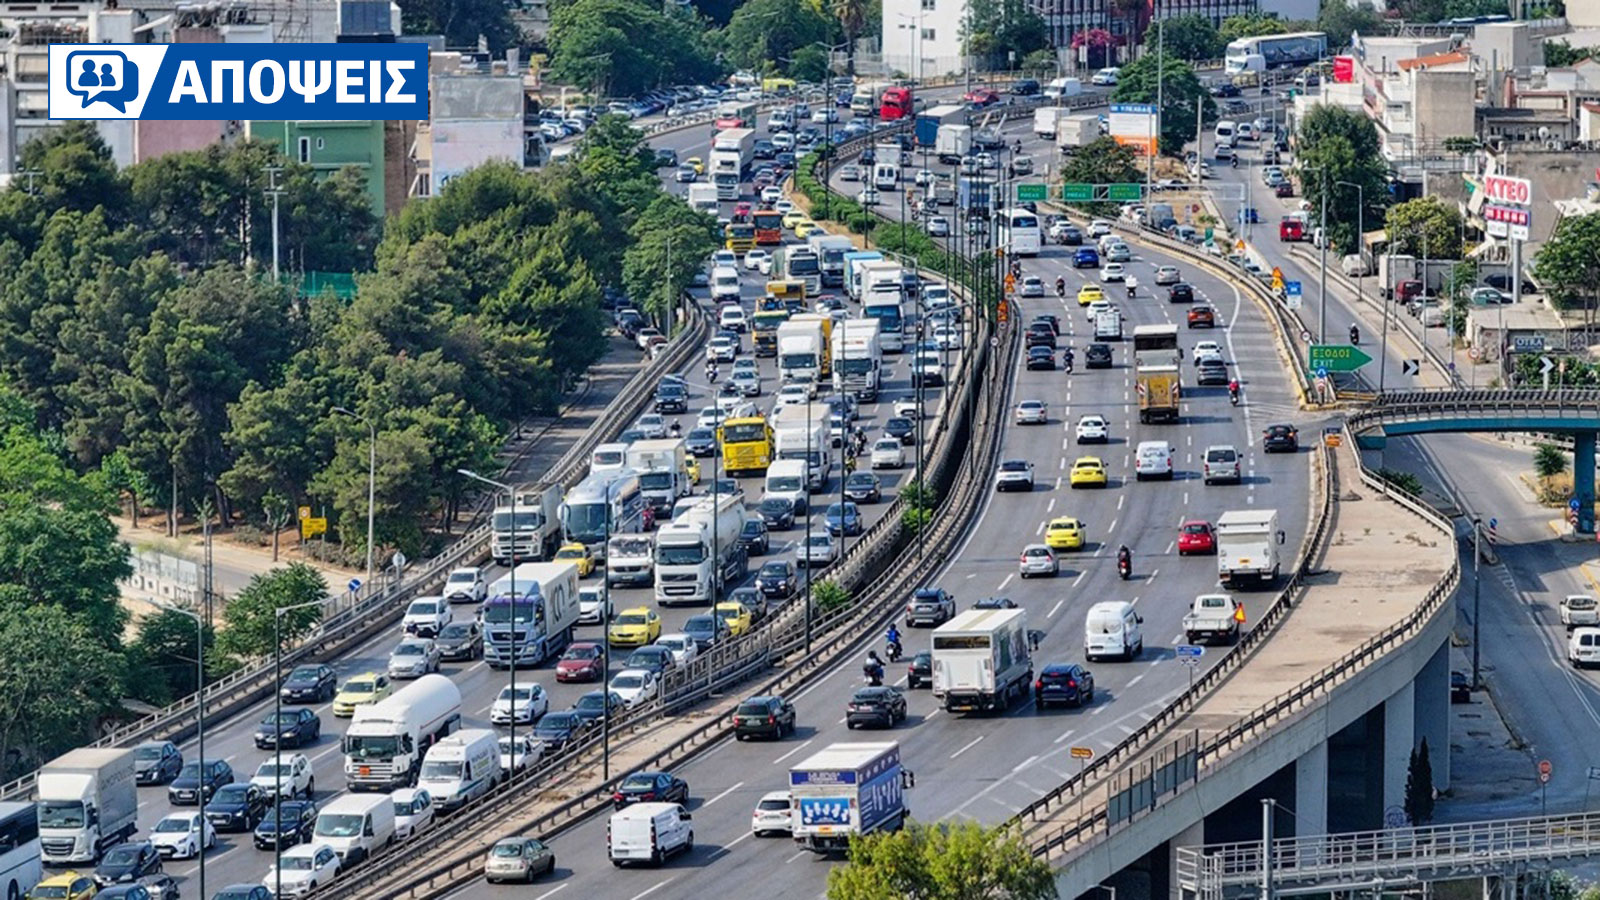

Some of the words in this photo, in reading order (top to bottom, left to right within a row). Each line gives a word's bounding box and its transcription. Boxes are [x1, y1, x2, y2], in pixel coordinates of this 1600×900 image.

[1485, 176, 1528, 203] ΚΤΕΟ
[1312, 348, 1351, 358] ΕΞΟΔΟΣ
[1312, 359, 1335, 368] EXIT
